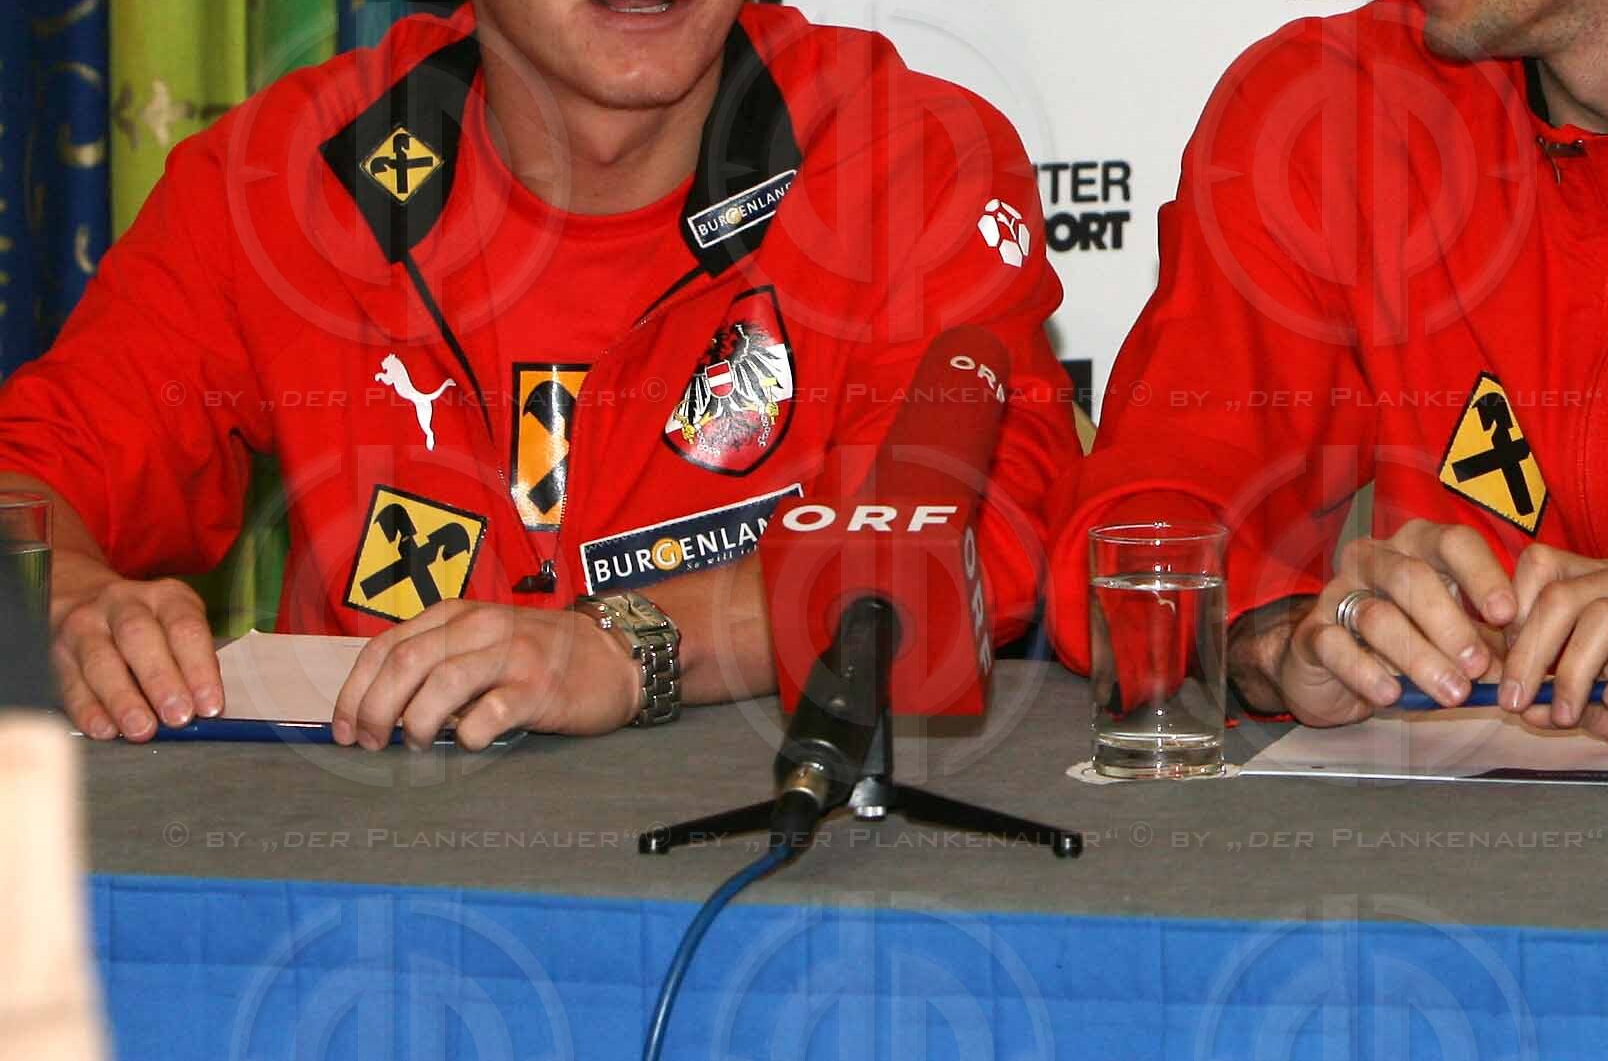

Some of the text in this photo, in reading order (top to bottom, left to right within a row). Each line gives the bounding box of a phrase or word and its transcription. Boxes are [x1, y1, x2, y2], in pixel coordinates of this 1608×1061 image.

[1034, 161, 1131, 204] TER
[1046, 211, 1131, 252] ORT
[782, 504, 959, 533] ORF
